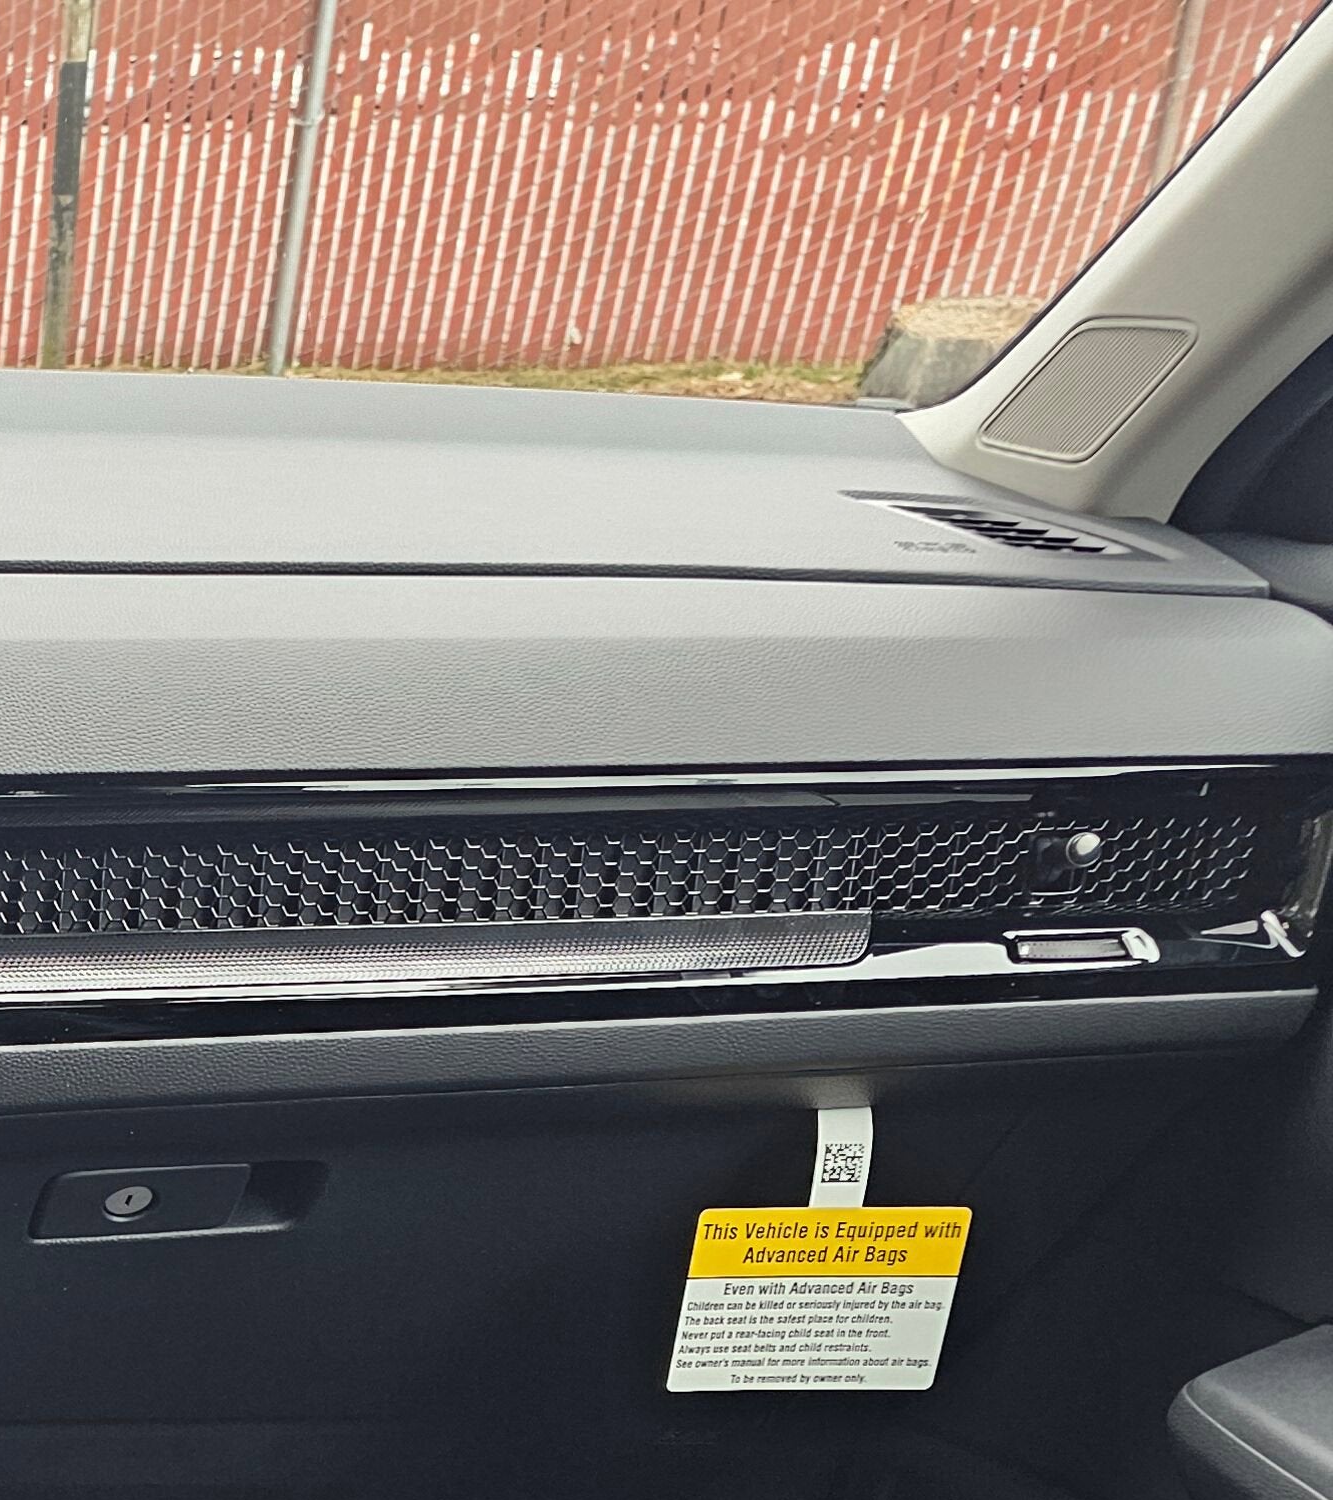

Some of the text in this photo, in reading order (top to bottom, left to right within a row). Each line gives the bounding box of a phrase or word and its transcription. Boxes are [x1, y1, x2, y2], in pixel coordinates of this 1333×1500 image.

[704, 1221, 962, 1241] This Vehicle is Equipped with
[743, 1246, 908, 1266] Advanced Air Bags
[723, 1282, 914, 1297] Even with Advanced Air Bags
[687, 1300, 945, 1311] Children can be killed or seriously injured by the air bag.
[685, 1314, 893, 1325] The back seat is the safest place for children.
[681, 1329, 891, 1341] Never put a rear-facing child seat in the front.
[678, 1345, 710, 1355] Always
[731, 1344, 751, 1353] seat
[753, 1344, 776, 1353] belts
[779, 1343, 796, 1353] and
[798, 1343, 822, 1352] child
[824, 1343, 872, 1352] restraints.
[676, 1357, 932, 1368] See owner's manual for more information about air bags.
[731, 1373, 867, 1384] To be removed by owner only.
